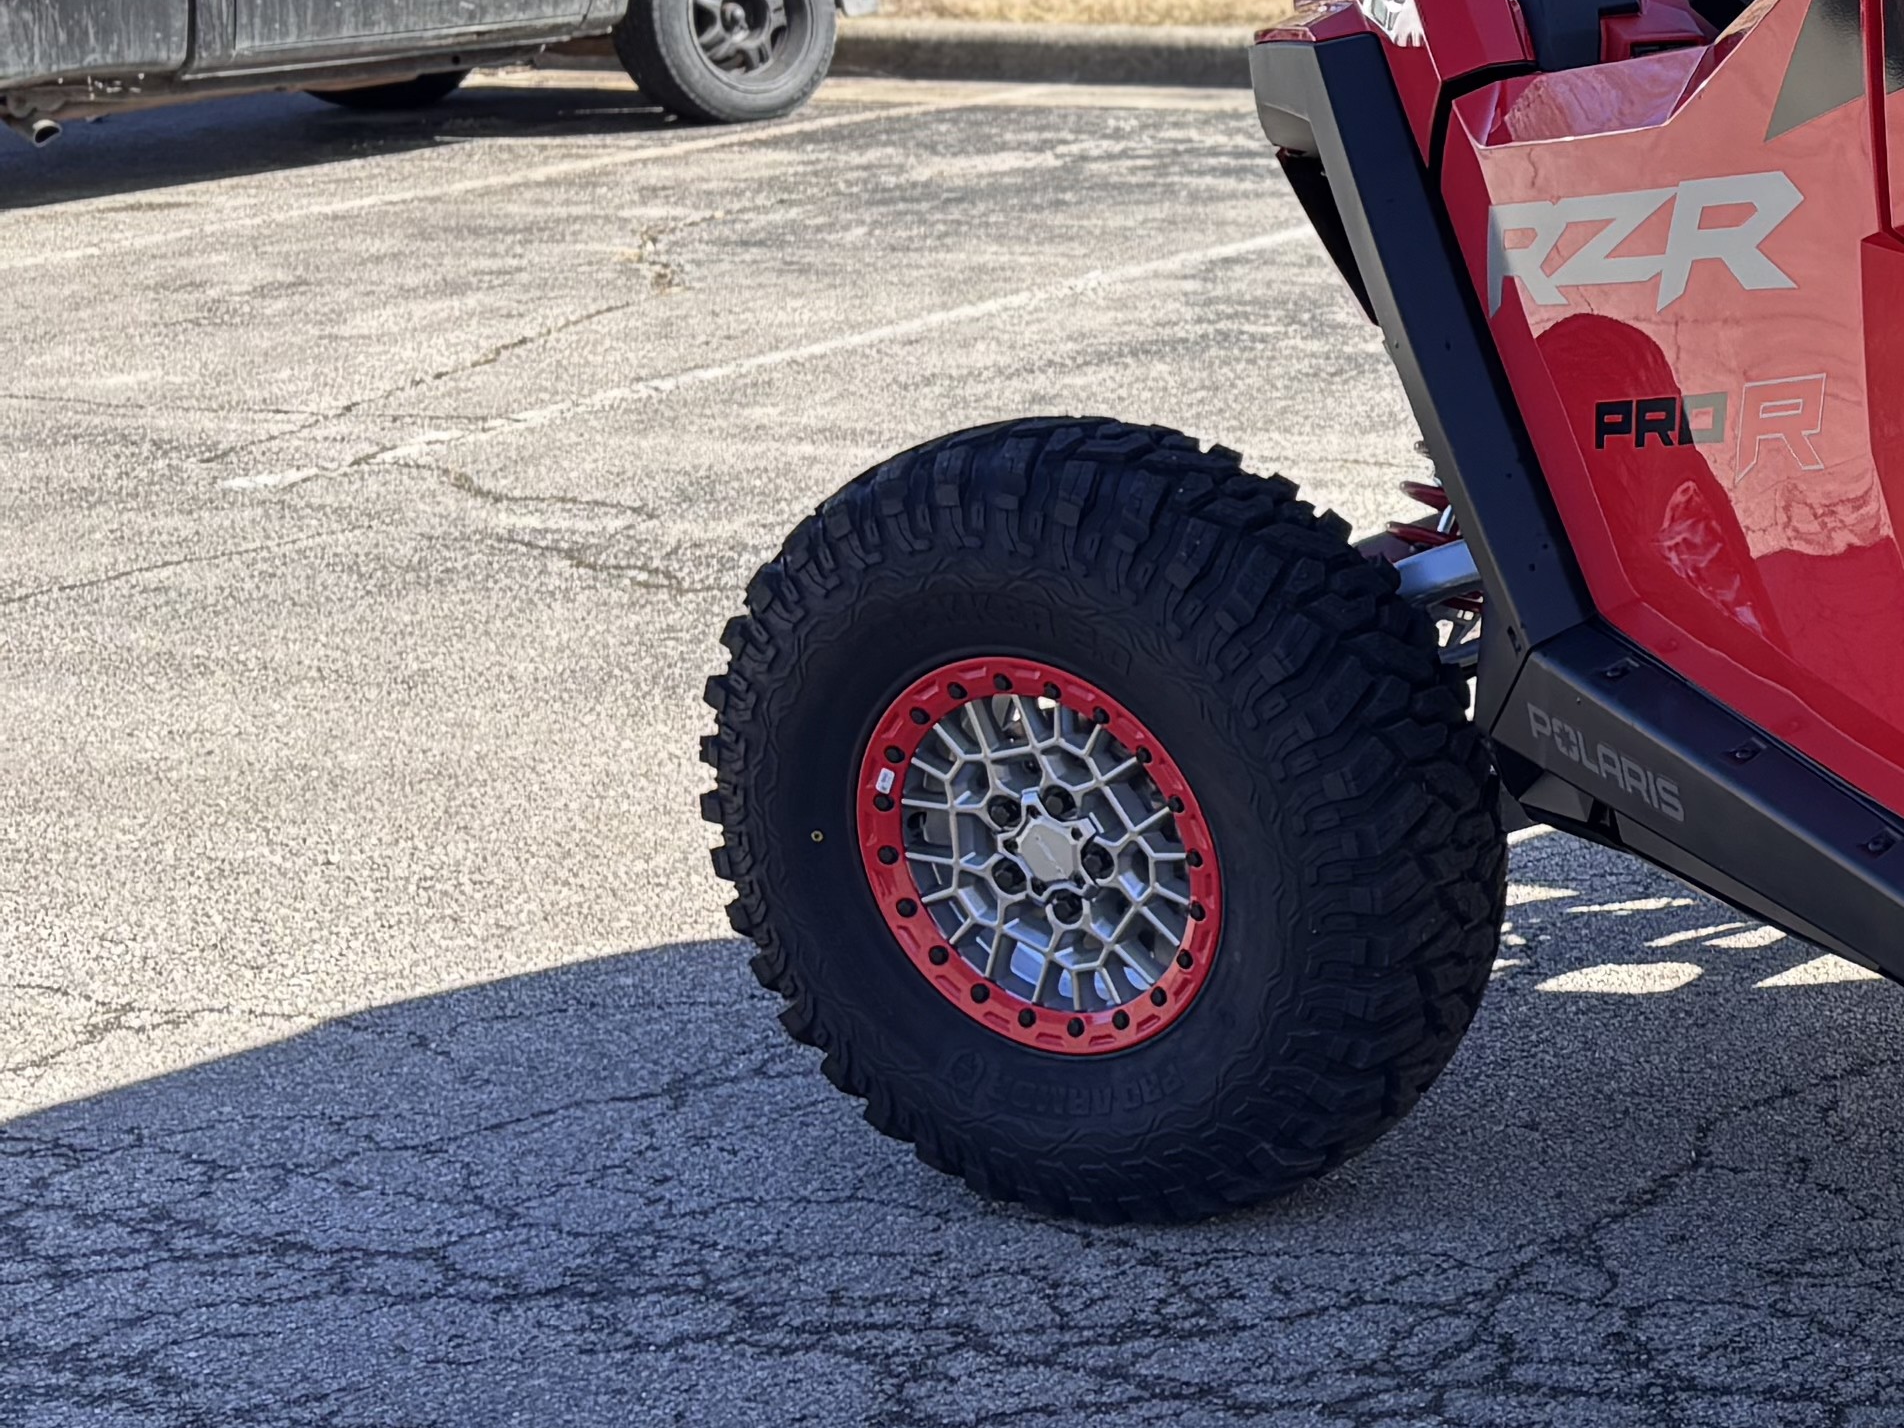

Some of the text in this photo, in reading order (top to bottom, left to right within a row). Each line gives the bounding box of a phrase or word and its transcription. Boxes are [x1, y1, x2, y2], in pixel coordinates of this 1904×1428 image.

[1487, 171, 1805, 318] RZR
[1594, 372, 1827, 485] PRO R
[1527, 702, 1685, 822] POLARIS
